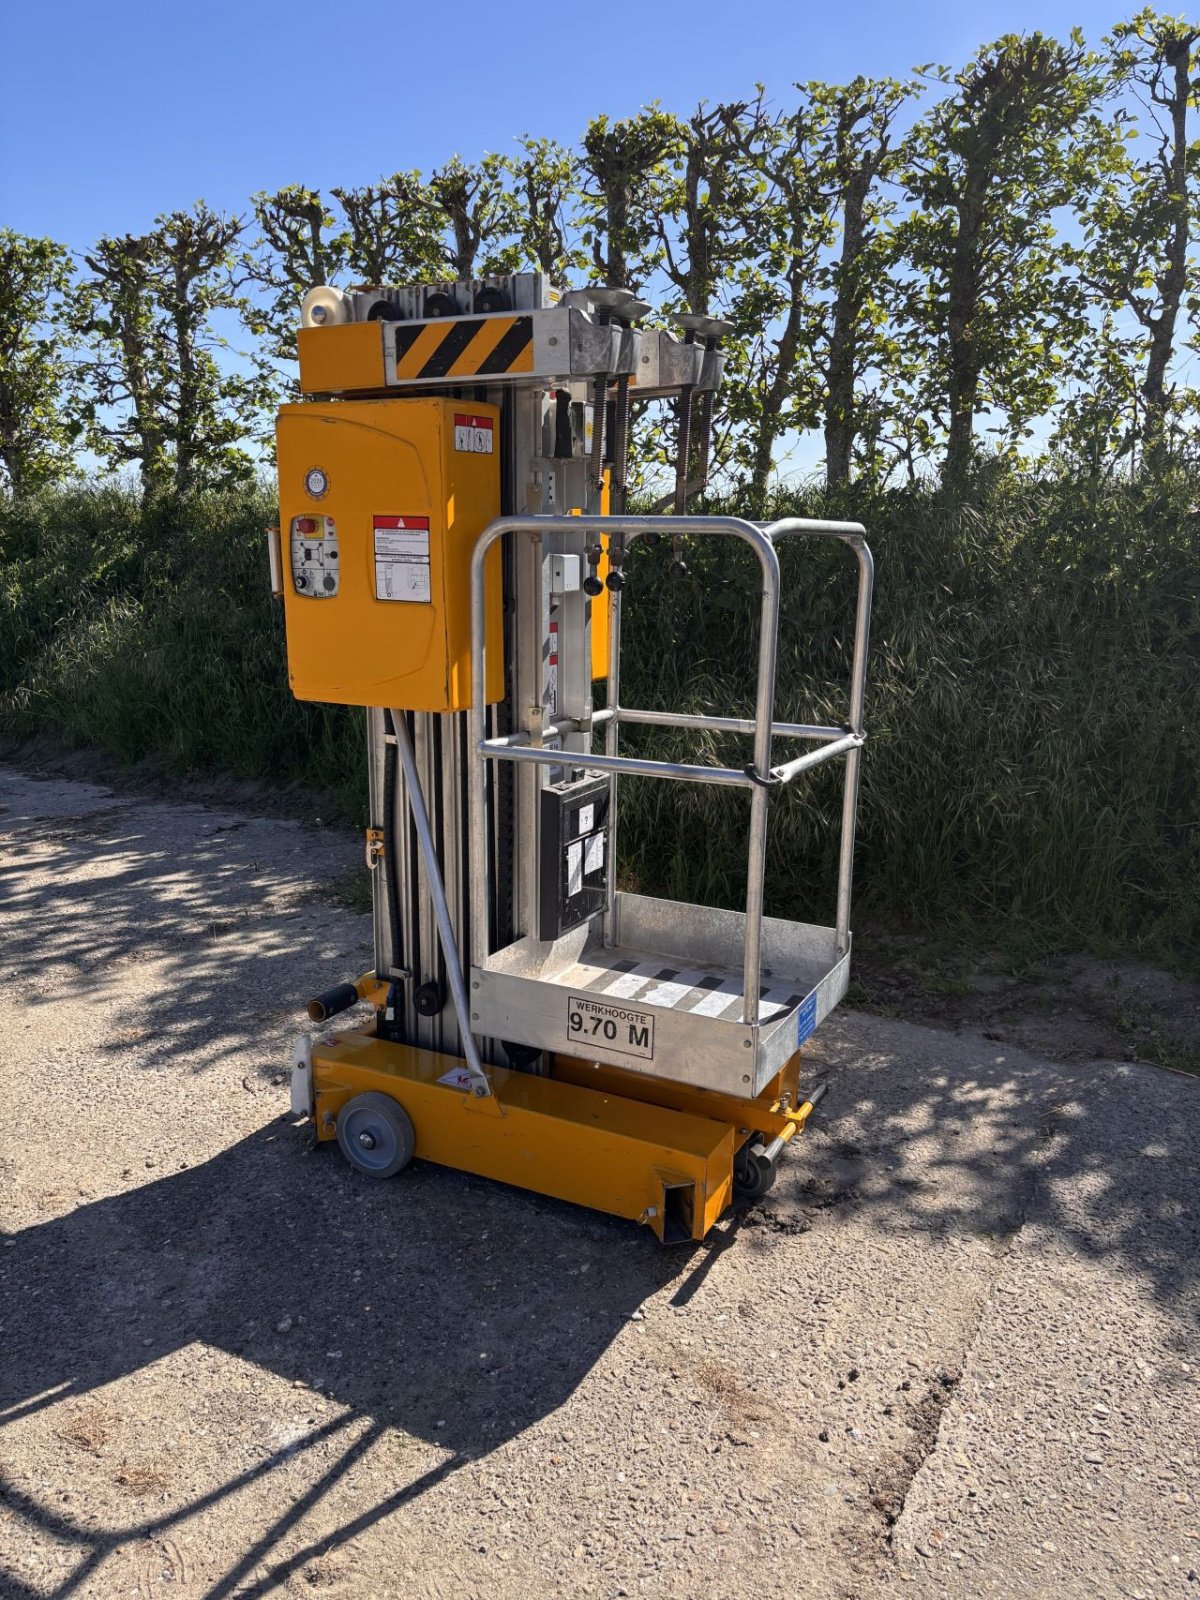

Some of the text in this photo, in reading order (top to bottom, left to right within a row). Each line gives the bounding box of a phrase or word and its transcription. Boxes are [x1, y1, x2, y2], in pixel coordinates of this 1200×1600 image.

[576, 1001, 647, 1024] WERKHOOGTE
[570, 1012, 649, 1048] 9.70 M
